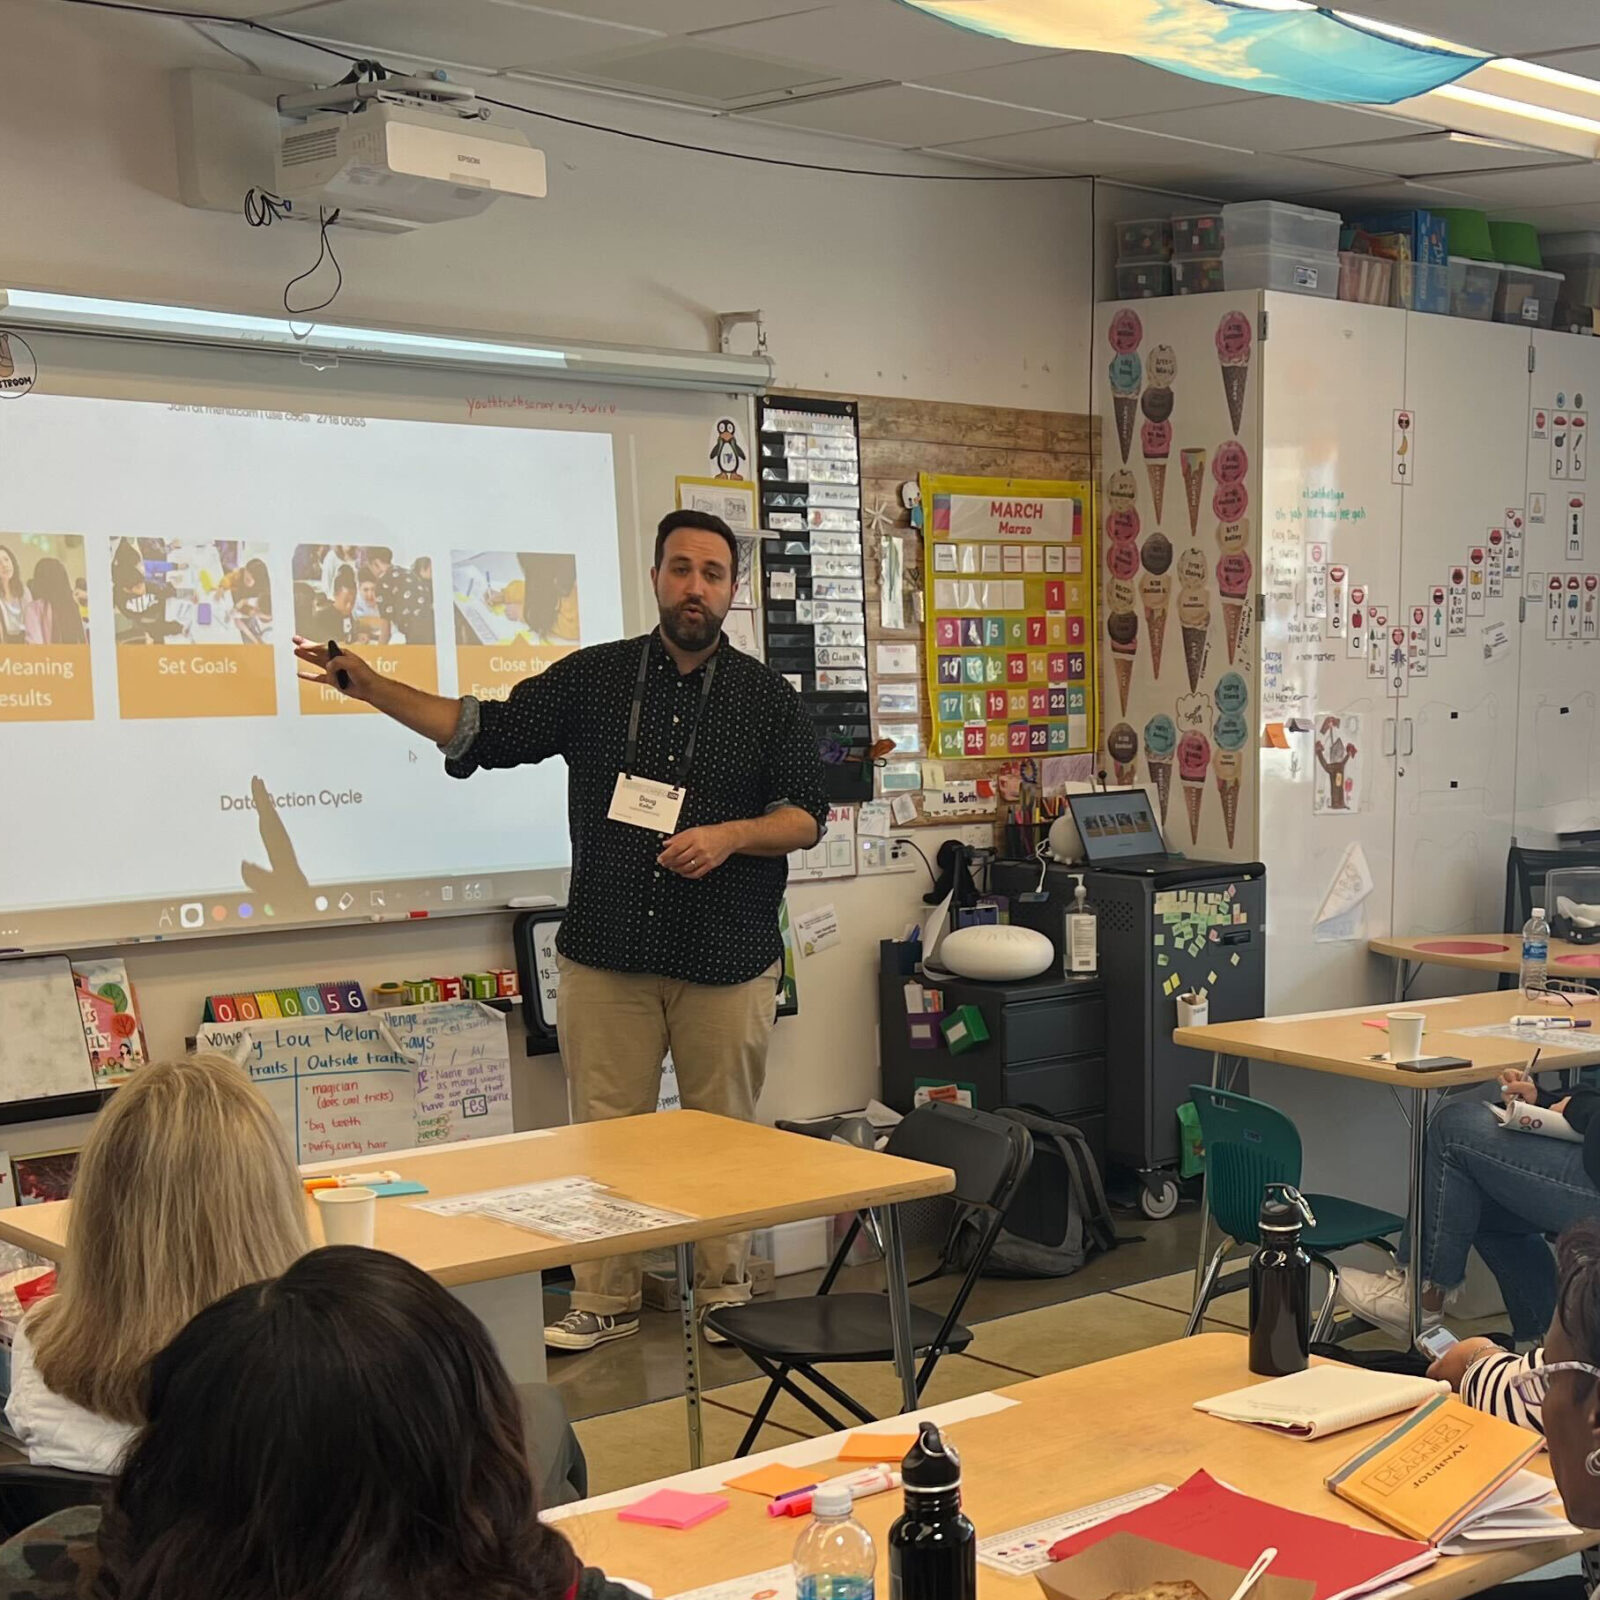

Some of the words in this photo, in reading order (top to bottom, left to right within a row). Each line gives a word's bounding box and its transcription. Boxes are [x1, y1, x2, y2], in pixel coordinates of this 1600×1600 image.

[457, 154, 480, 165] EPSON
[1397, 463, 1407, 476] a
[1555, 458, 1563, 475] p
[1573, 454, 1582, 472] b
[990, 501, 1043, 519] MARCH
[998, 521, 1032, 535] Marzo
[1569, 539, 1580, 551] m
[1051, 587, 1058, 602] 1
[1071, 588, 1079, 601] 2
[1471, 591, 1481, 601] oo
[1332, 616, 1340, 629] e
[1551, 614, 1559, 632] f
[1569, 615, 1576, 626] v
[1583, 615, 1595, 633] th
[944, 624, 953, 638] 3
[991, 624, 998, 637] 5
[1012, 624, 1021, 637] 6
[1033, 623, 1041, 638] 7
[1053, 625, 1060, 638] 8
[1072, 623, 1079, 637] 9
[1352, 636, 1360, 649] a
[1434, 635, 1441, 648] u
[0, 657, 75, 679] Meaning
[158, 657, 187, 675] Set
[190, 657, 238, 675] Goals
[376, 657, 398, 674] for
[489, 657, 526, 674] Close
[942, 662, 957, 676] 10
[1010, 660, 1024, 674] 13
[1031, 659, 1044, 673] 14
[1052, 659, 1064, 673] 15
[1070, 658, 1082, 672] 16
[1393, 676, 1403, 689] o
[944, 698, 958, 712] 17
[990, 697, 1004, 711] 19
[1011, 697, 1026, 710] 20
[1032, 695, 1045, 709] 21
[1050, 695, 1065, 708] 22
[1070, 694, 1083, 707] 23
[967, 733, 983, 748] 25
[990, 733, 1005, 747] 26
[1012, 732, 1026, 746] 27
[1031, 730, 1046, 745] 28
[1051, 730, 1066, 744] 29
[319, 788, 363, 808] Cycle
[956, 792, 978, 803] Beth
[541, 946, 552, 958] 10
[540, 969, 551, 980] 15
[546, 988, 557, 999] 20
[275, 1029, 312, 1049] Lou
[324, 1023, 380, 1044] Melon
[250, 1061, 289, 1077] traits
[307, 1053, 360, 1071] Outside
[435, 1069, 462, 1080] Name
[467, 1063, 483, 1076] and
[312, 1081, 359, 1098] magician
[436, 1081, 448, 1090] as
[451, 1077, 477, 1089] many
[316, 1097, 340, 1110] (does
[342, 1095, 360, 1106] cool
[364, 1090, 394, 1104] tricks)
[420, 1101, 445, 1113] have
[308, 1118, 326, 1134] big
[331, 1116, 361, 1128] teeth
[367, 1139, 388, 1150] hair
[1374, 1421, 1453, 1484] DEEPER
[1384, 1427, 1463, 1489] LEARNING
[1412, 1442, 1469, 1489] JOURNAL
